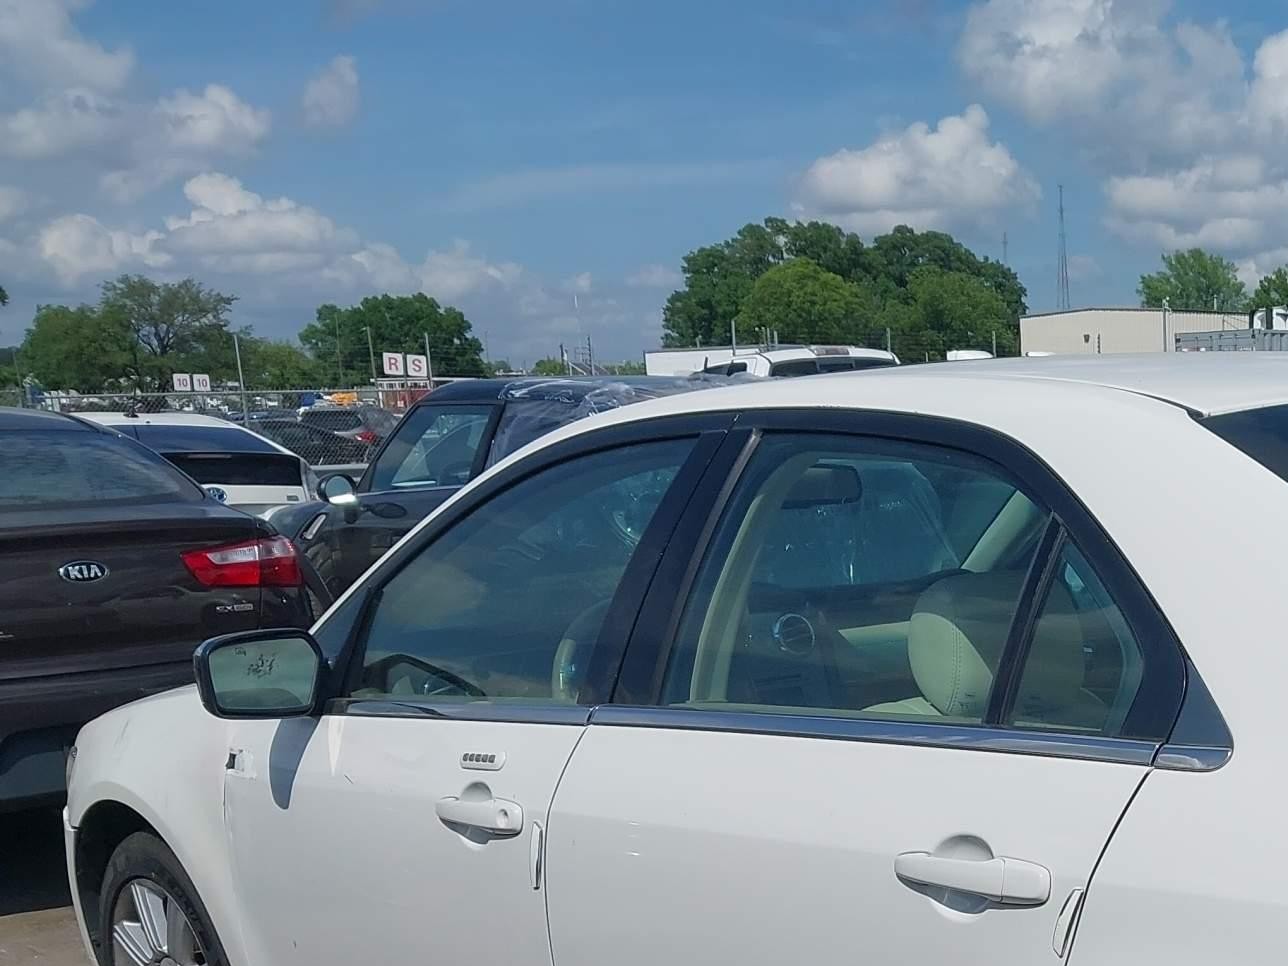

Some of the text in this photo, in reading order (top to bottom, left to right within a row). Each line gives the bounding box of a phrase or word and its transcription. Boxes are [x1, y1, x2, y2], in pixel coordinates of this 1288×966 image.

[387, 356, 400, 371] R
[411, 358, 423, 373] S
[176, 378, 188, 388] 10
[198, 378, 209, 388] 10
[68, 564, 103, 580] KIA
